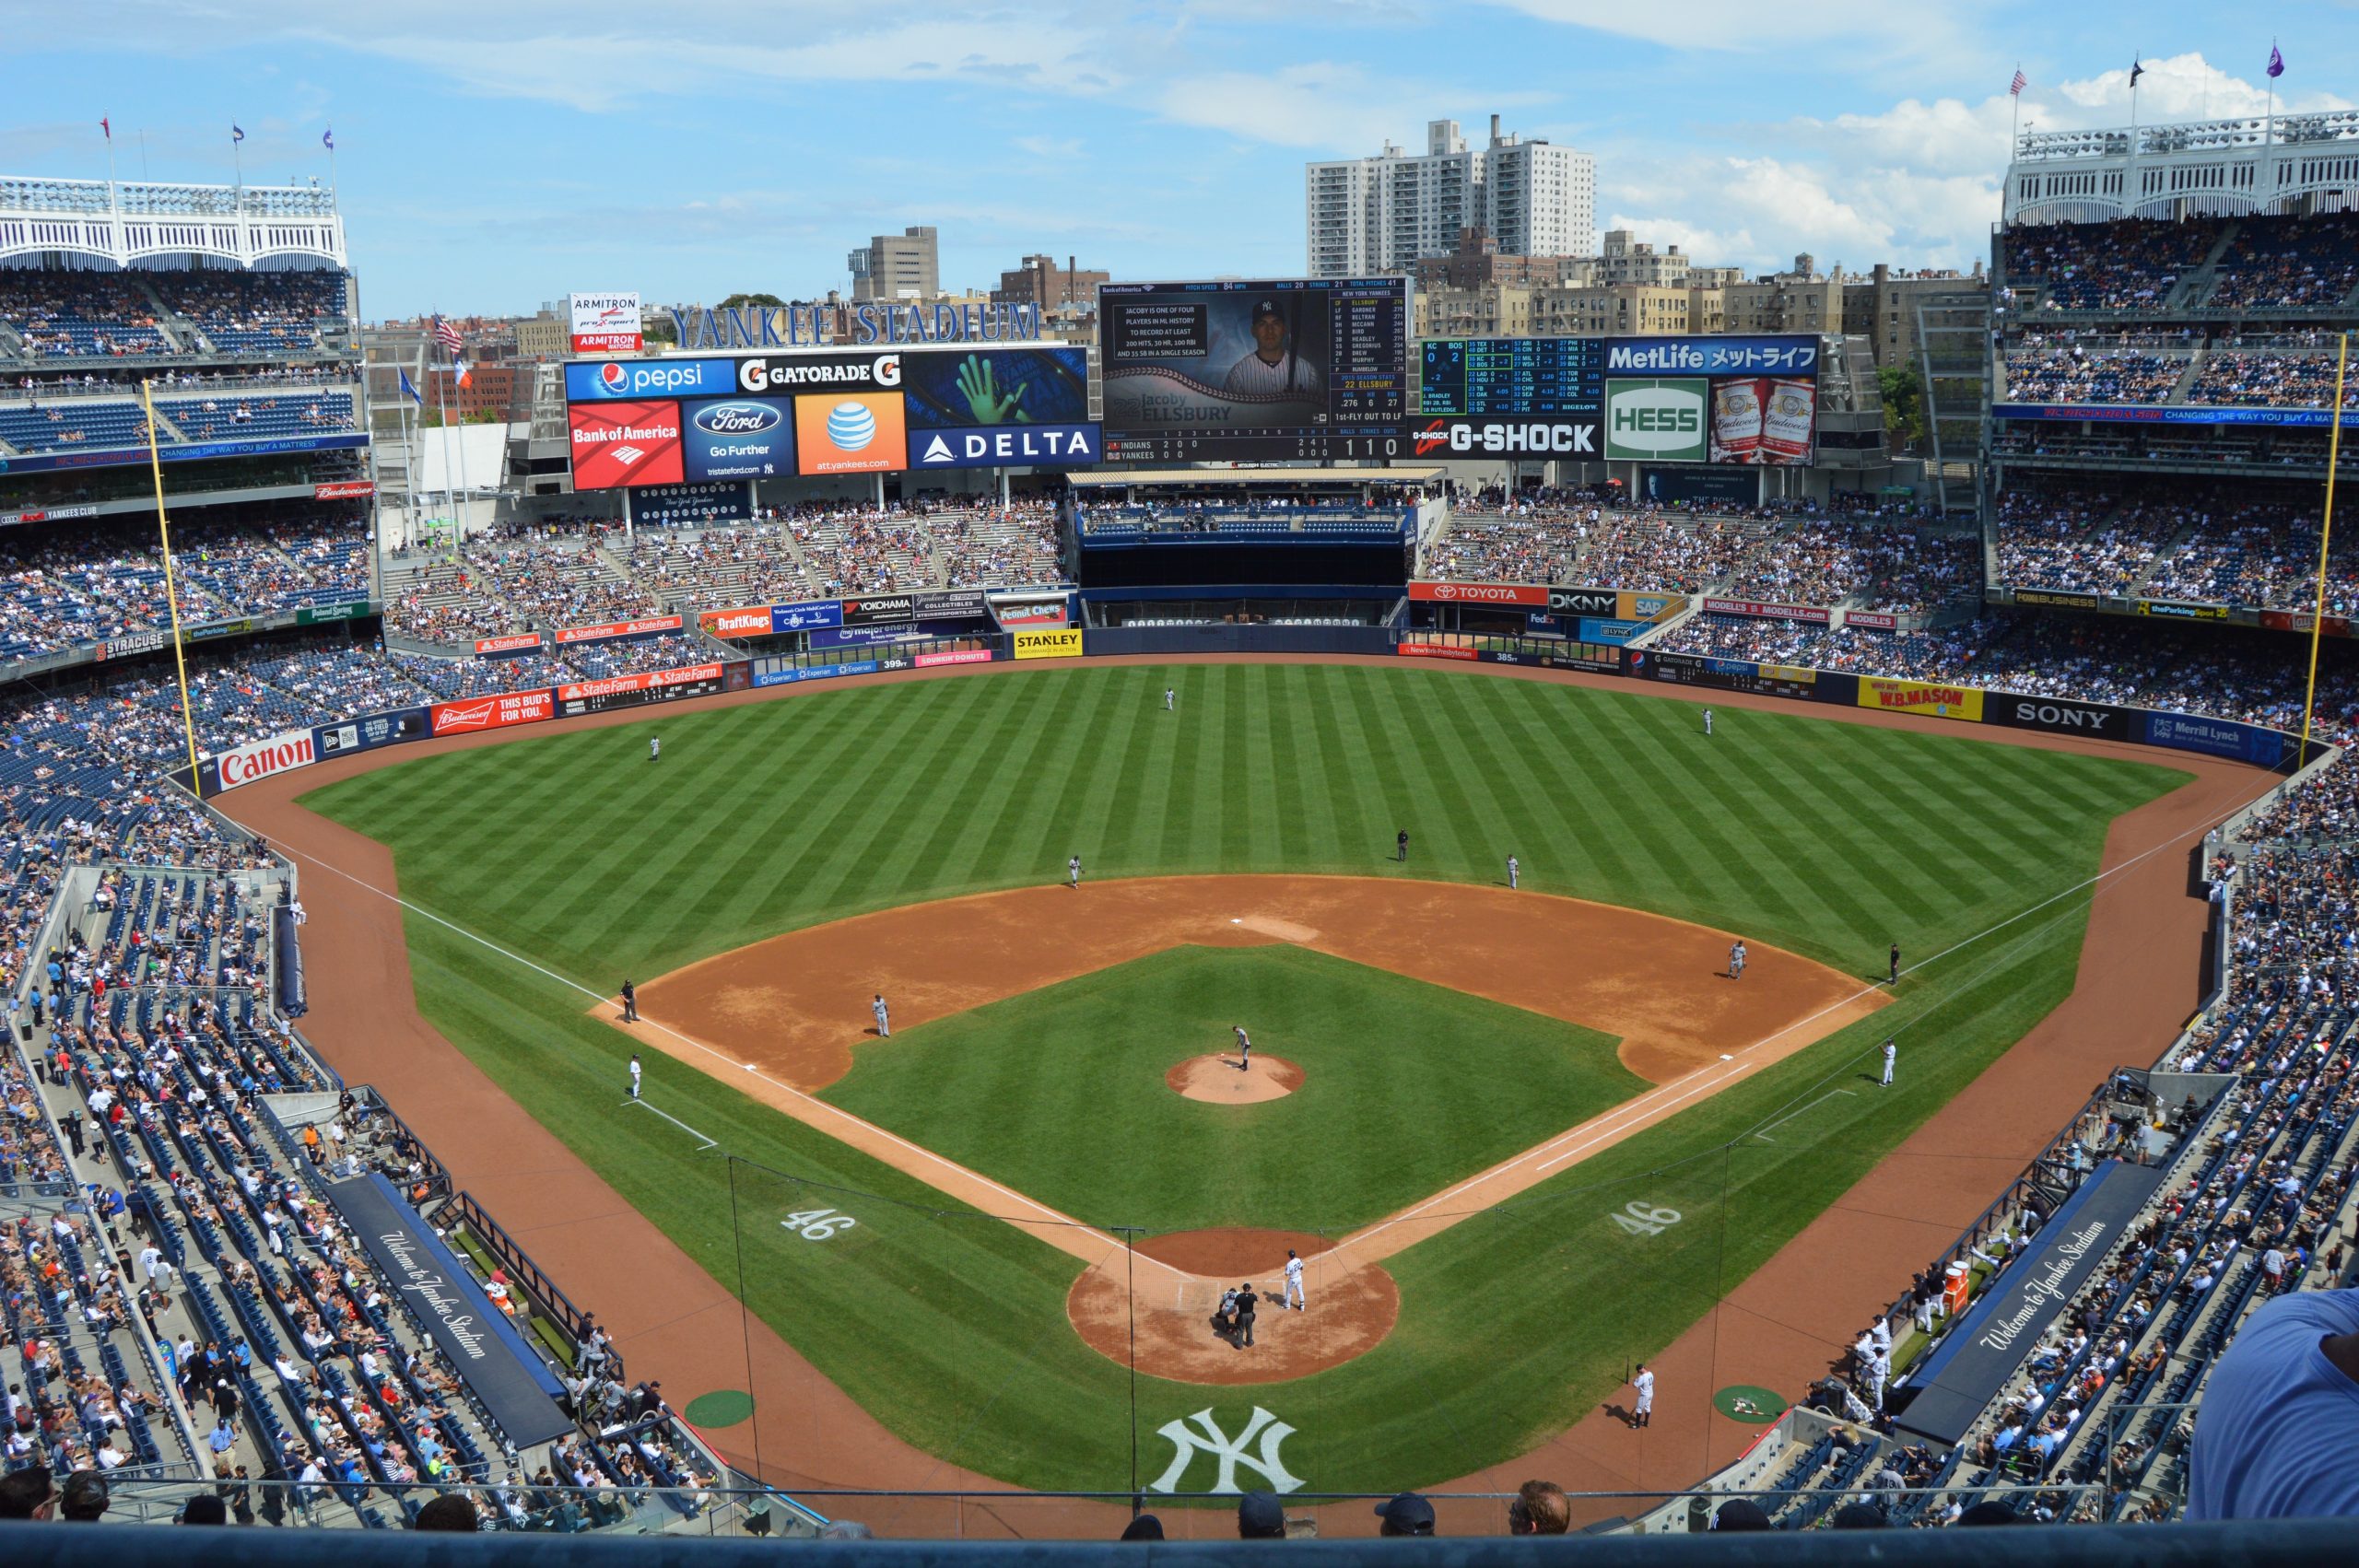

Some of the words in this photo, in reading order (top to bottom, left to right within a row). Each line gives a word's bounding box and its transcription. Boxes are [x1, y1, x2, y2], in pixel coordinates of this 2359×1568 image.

[1223, 282, 1233, 290] 84
[575, 299, 636, 309] ARMITRON
[670, 305, 834, 348] YANKEE
[856, 301, 1042, 345] STADIUM
[581, 335, 636, 345] ARMITRON
[1609, 344, 1704, 369] MetLife
[1711, 346, 1815, 368] メットライフ
[635, 364, 702, 393] pepsi
[740, 358, 769, 392] G
[770, 365, 871, 383] GATORADE
[874, 355, 901, 386] G
[1142, 393, 1187, 408] Jacoby
[711, 408, 763, 430] Ford
[1142, 406, 1231, 422] ELLSBURY
[1615, 407, 1698, 432] HESS
[2165, 410, 2215, 421] CHANGING
[2217, 411, 2236, 421] THE
[2236, 411, 2259, 421] WAY
[2260, 412, 2282, 422] YOU
[2283, 413, 2303, 422] BUY
[2305, 414, 2312, 422] A
[2314, 415, 2359, 425] MATRESS
[573, 428, 608, 443] Bank
[608, 427, 624, 441] of
[623, 425, 677, 440] America
[1413, 431, 1449, 439] G-SHOCK
[1450, 424, 1595, 452] G-SHOCK
[160, 448, 200, 458] CHANGING
[203, 446, 217, 455] THE
[217, 444, 236, 454] WAY
[237, 443, 254, 452] YOU
[256, 441, 271, 451] BUY
[279, 439, 316, 450] MATTRESS
[710, 446, 726, 457] Go
[728, 444, 769, 456] Further
[965, 431, 1090, 458] DELTA
[1346, 439, 1353, 456] 1
[1367, 439, 1373, 456] 1
[1386, 439, 1397, 456] 0
[1121, 451, 1155, 460] YANKEES
[708, 465, 759, 475] tristateford.com
[816, 459, 889, 470] att.yankees.com
[316, 486, 373, 498] Budweiser
[20, 511, 45, 522] Audi
[47, 509, 78, 520] YANKEES
[79, 507, 97, 517] CLUB
[915, 594, 945, 607] Yankees
[949, 592, 982, 601] STEINER
[1459, 587, 1517, 600] TOYOTA
[859, 600, 910, 611] YOKOHAMA
[1549, 593, 1615, 613] DKNY
[1637, 601, 1663, 614] SAP
[2038, 595, 2096, 608] BUSINESS
[311, 606, 333, 619] Poland
[333, 605, 353, 617] Spring
[916, 609, 983, 618] STEINERSPORTS.COM
[1000, 608, 1031, 621] Peanut
[1032, 604, 1062, 615] Chews
[1707, 600, 1746, 613] MODELL'S
[1762, 606, 1825, 620] MODELLS.com
[718, 614, 770, 630] DraftKings
[1531, 613, 1555, 625] FedEx
[1849, 614, 1892, 626] MODELL'S
[193, 624, 243, 638] theParkingSpot
[107, 633, 164, 654] SYRACUSE
[1018, 635, 1077, 647] STANLEY
[927, 655, 954, 663] DUNKIN'
[955, 653, 984, 661] DONUTS
[1655, 654, 1661, 662] G
[1663, 657, 1693, 665] GATORADE
[1696, 660, 1702, 668] G
[807, 668, 830, 678] Experian
[848, 663, 872, 673] Experian
[1726, 662, 1748, 672] pepsi
[769, 673, 792, 683] Experian
[500, 697, 521, 709] THIS
[523, 693, 550, 707] BUD'S
[1880, 688, 1964, 708] W.B.MASON
[442, 710, 489, 724] Budweiser
[501, 709, 520, 721] FOR
[522, 707, 543, 719] YOU.
[566, 706, 586, 714] YANKEES
[2017, 703, 2110, 729] SONY
[342, 730, 355, 738] NEW
[365, 723, 388, 733] ON-FIELD
[2176, 721, 2208, 736] Merrill
[2211, 728, 2239, 742] Lynch
[342, 735, 356, 744] ERA
[221, 737, 313, 785] Canon
[780, 1209, 856, 1240] 46
[1610, 1200, 1682, 1236] 46
[2058, 1221, 2107, 1260] Stadium
[380, 1230, 417, 1271] Welcome
[408, 1269, 430, 1280] to
[1293, 1262, 1302, 1272] 22
[2025, 1258, 2075, 1300] Yankee
[401, 1276, 460, 1316] Yankee
[2024, 1293, 2046, 1309] to
[1980, 1304, 2038, 1351] Welcome
[442, 1315, 486, 1360] Stadium
[1150, 1405, 1308, 1493] NY
